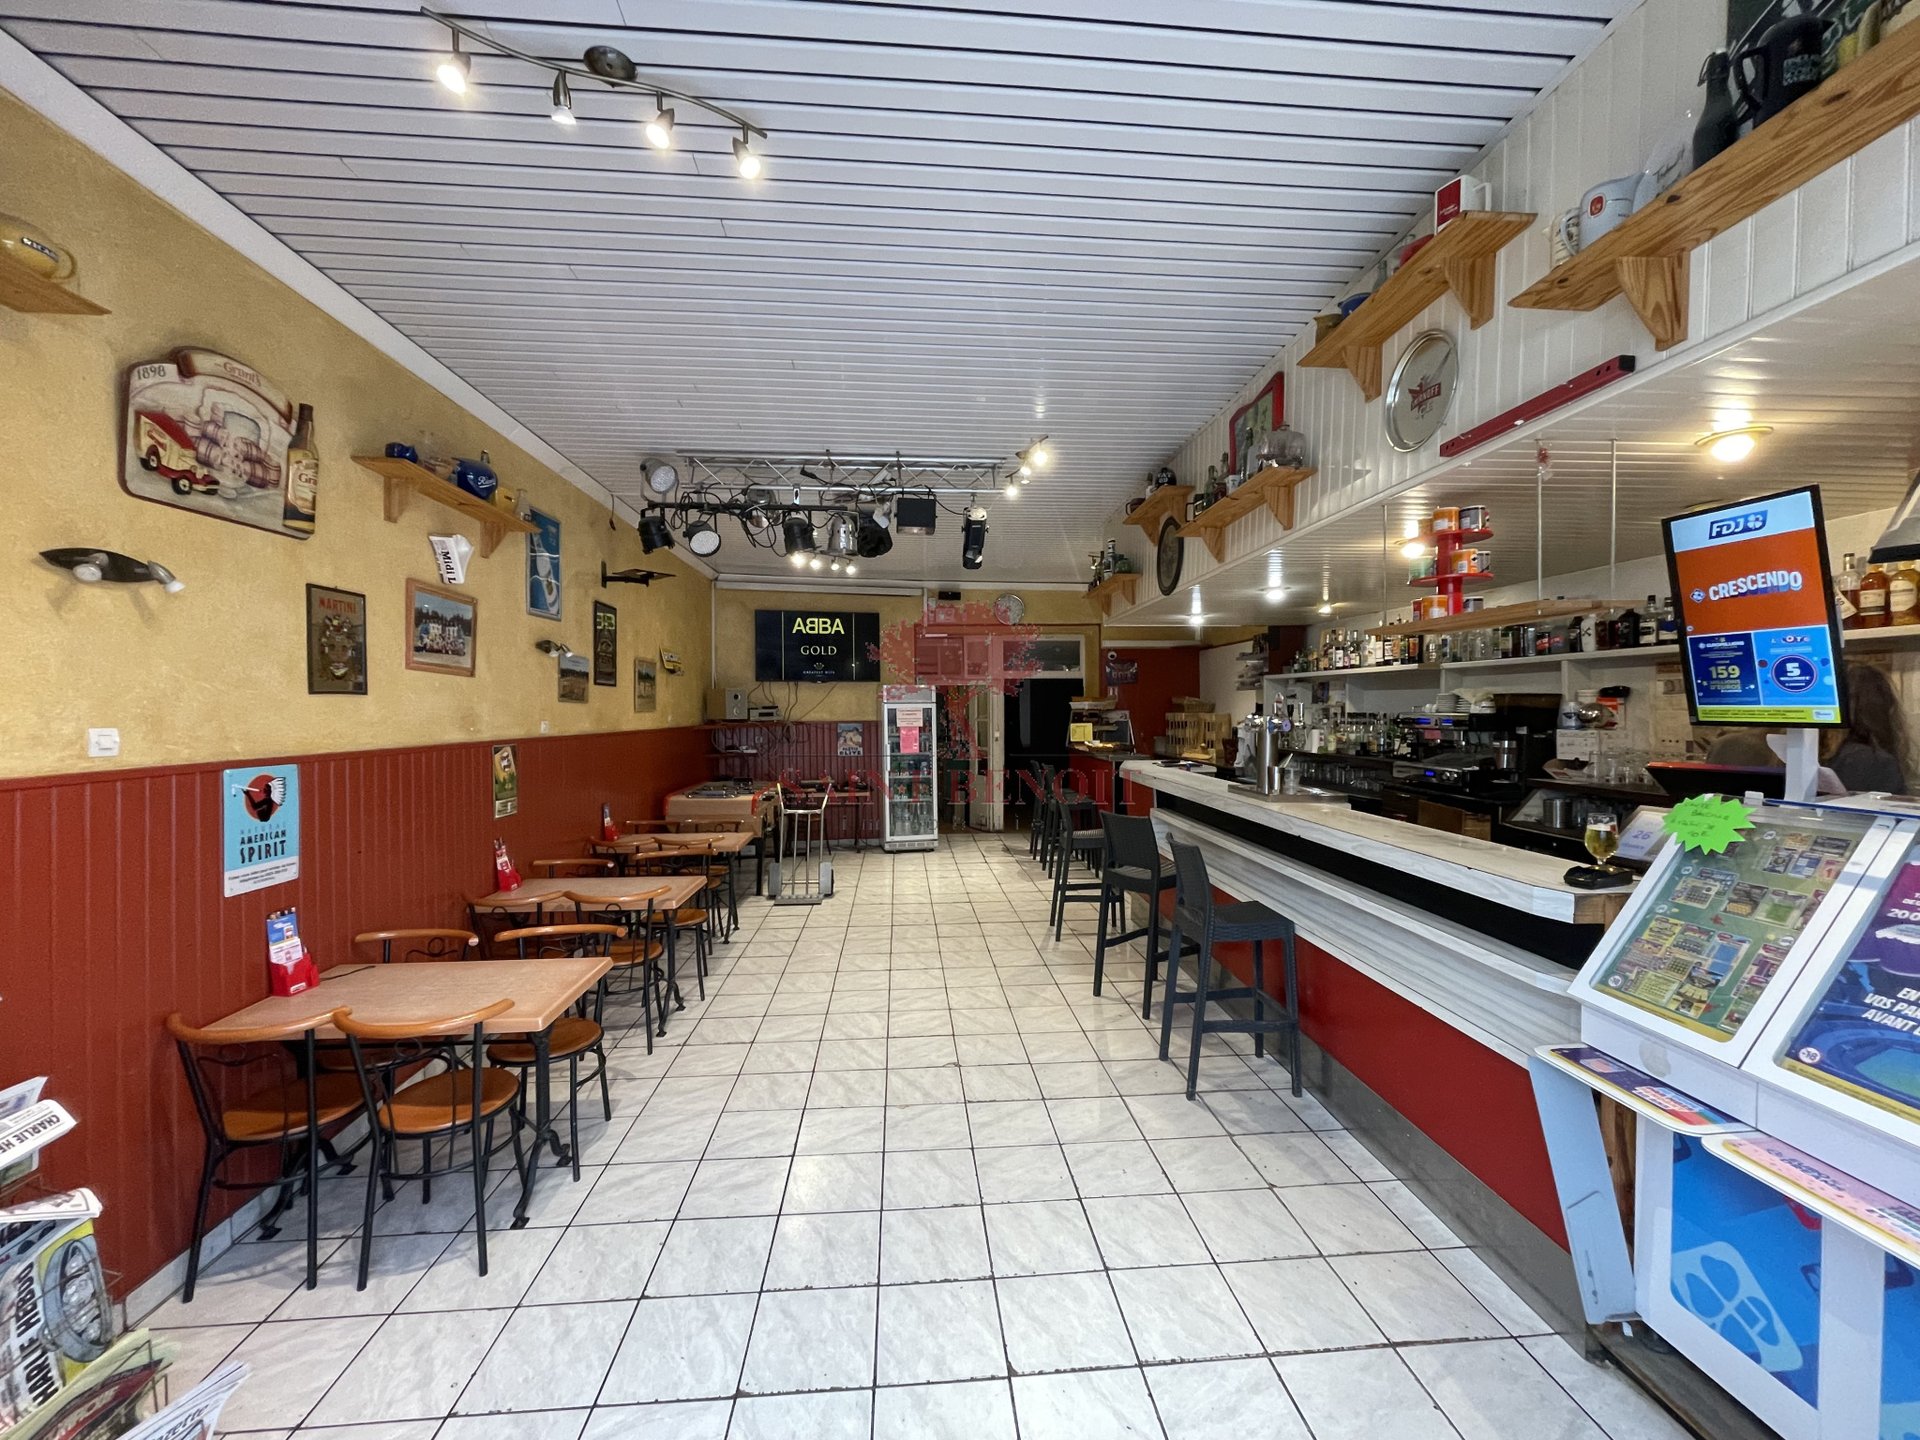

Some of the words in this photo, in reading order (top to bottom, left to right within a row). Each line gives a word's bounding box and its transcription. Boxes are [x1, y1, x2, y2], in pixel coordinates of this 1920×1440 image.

[137, 365, 166, 381] 1898
[223, 361, 262, 387] Grant's
[1711, 517, 1745, 537] FDJ
[441, 551, 456, 574] Midi
[1708, 570, 1803, 601] CRESCENDO
[319, 596, 357, 615] MARTINI
[792, 617, 845, 635] ABBA
[800, 645, 838, 656] GOLD
[1708, 665, 1741, 679] 159
[1786, 662, 1801, 677] 5
[240, 829, 287, 846] AMERICAN
[1632, 830, 1654, 841] 26
[240, 840, 287, 864] SPIRIT
[1864, 992, 1896, 1011] VOS
[1862, 1009, 1918, 1032] AVANT
[14, 1114, 61, 1144] CHARLIE
[16, 1261, 42, 1338] HEBDO
